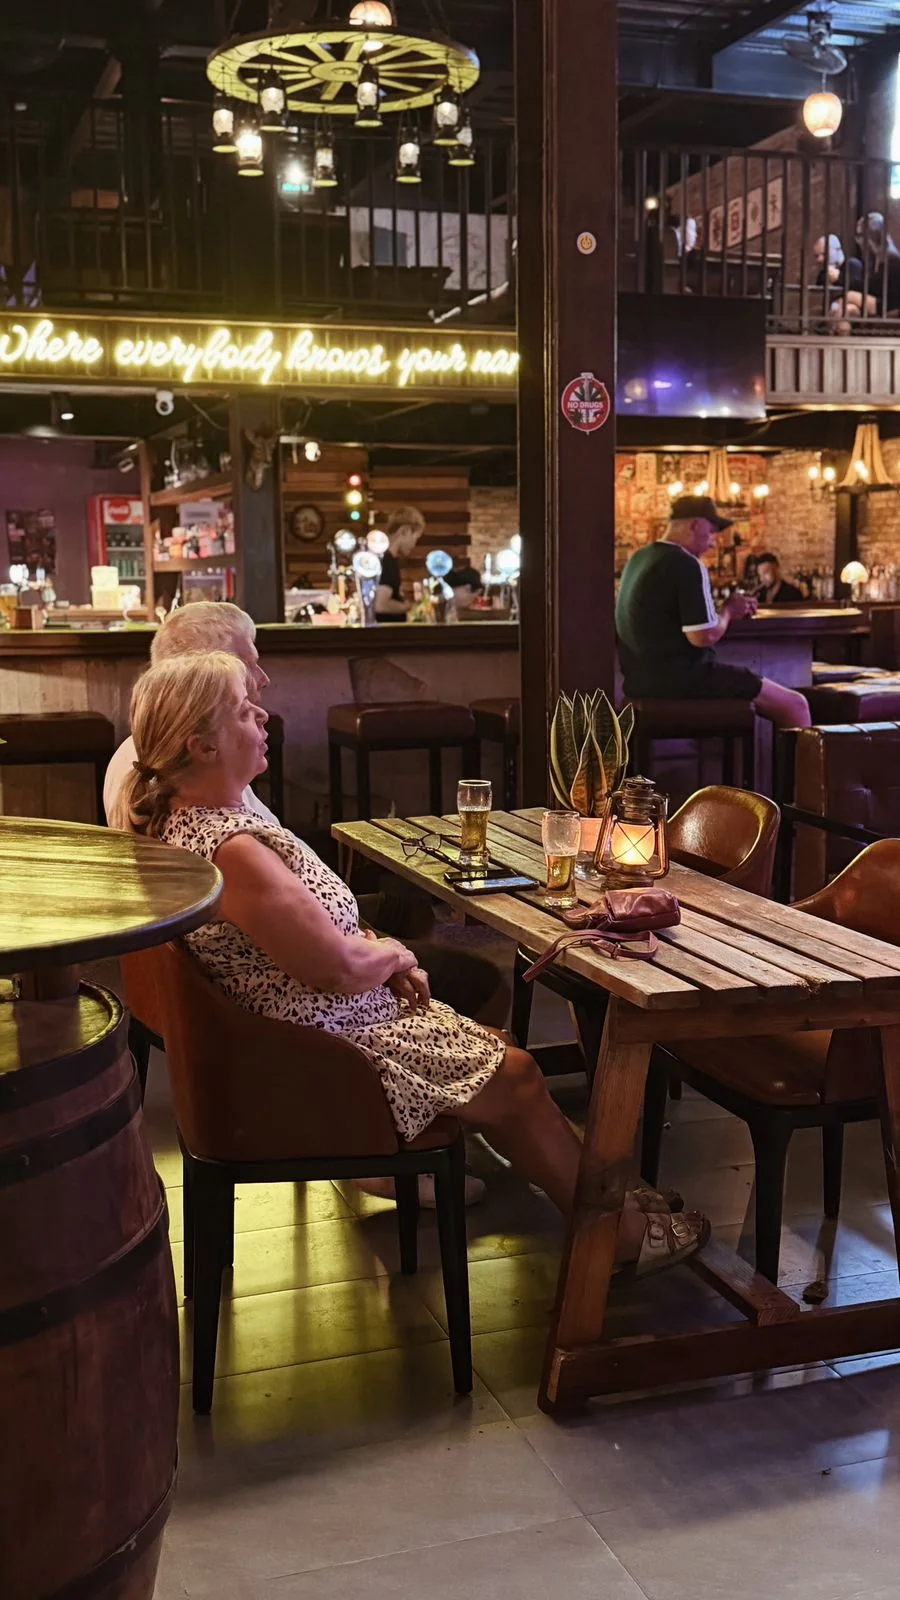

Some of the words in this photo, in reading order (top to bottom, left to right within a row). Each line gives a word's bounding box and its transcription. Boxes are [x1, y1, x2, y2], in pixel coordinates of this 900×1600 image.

[115, 328, 281, 384] everybody
[286, 330, 390, 375] knows
[397, 344, 467, 387] your
[567, 401, 579, 409] NO
[580, 401, 603, 409] DRUGS
